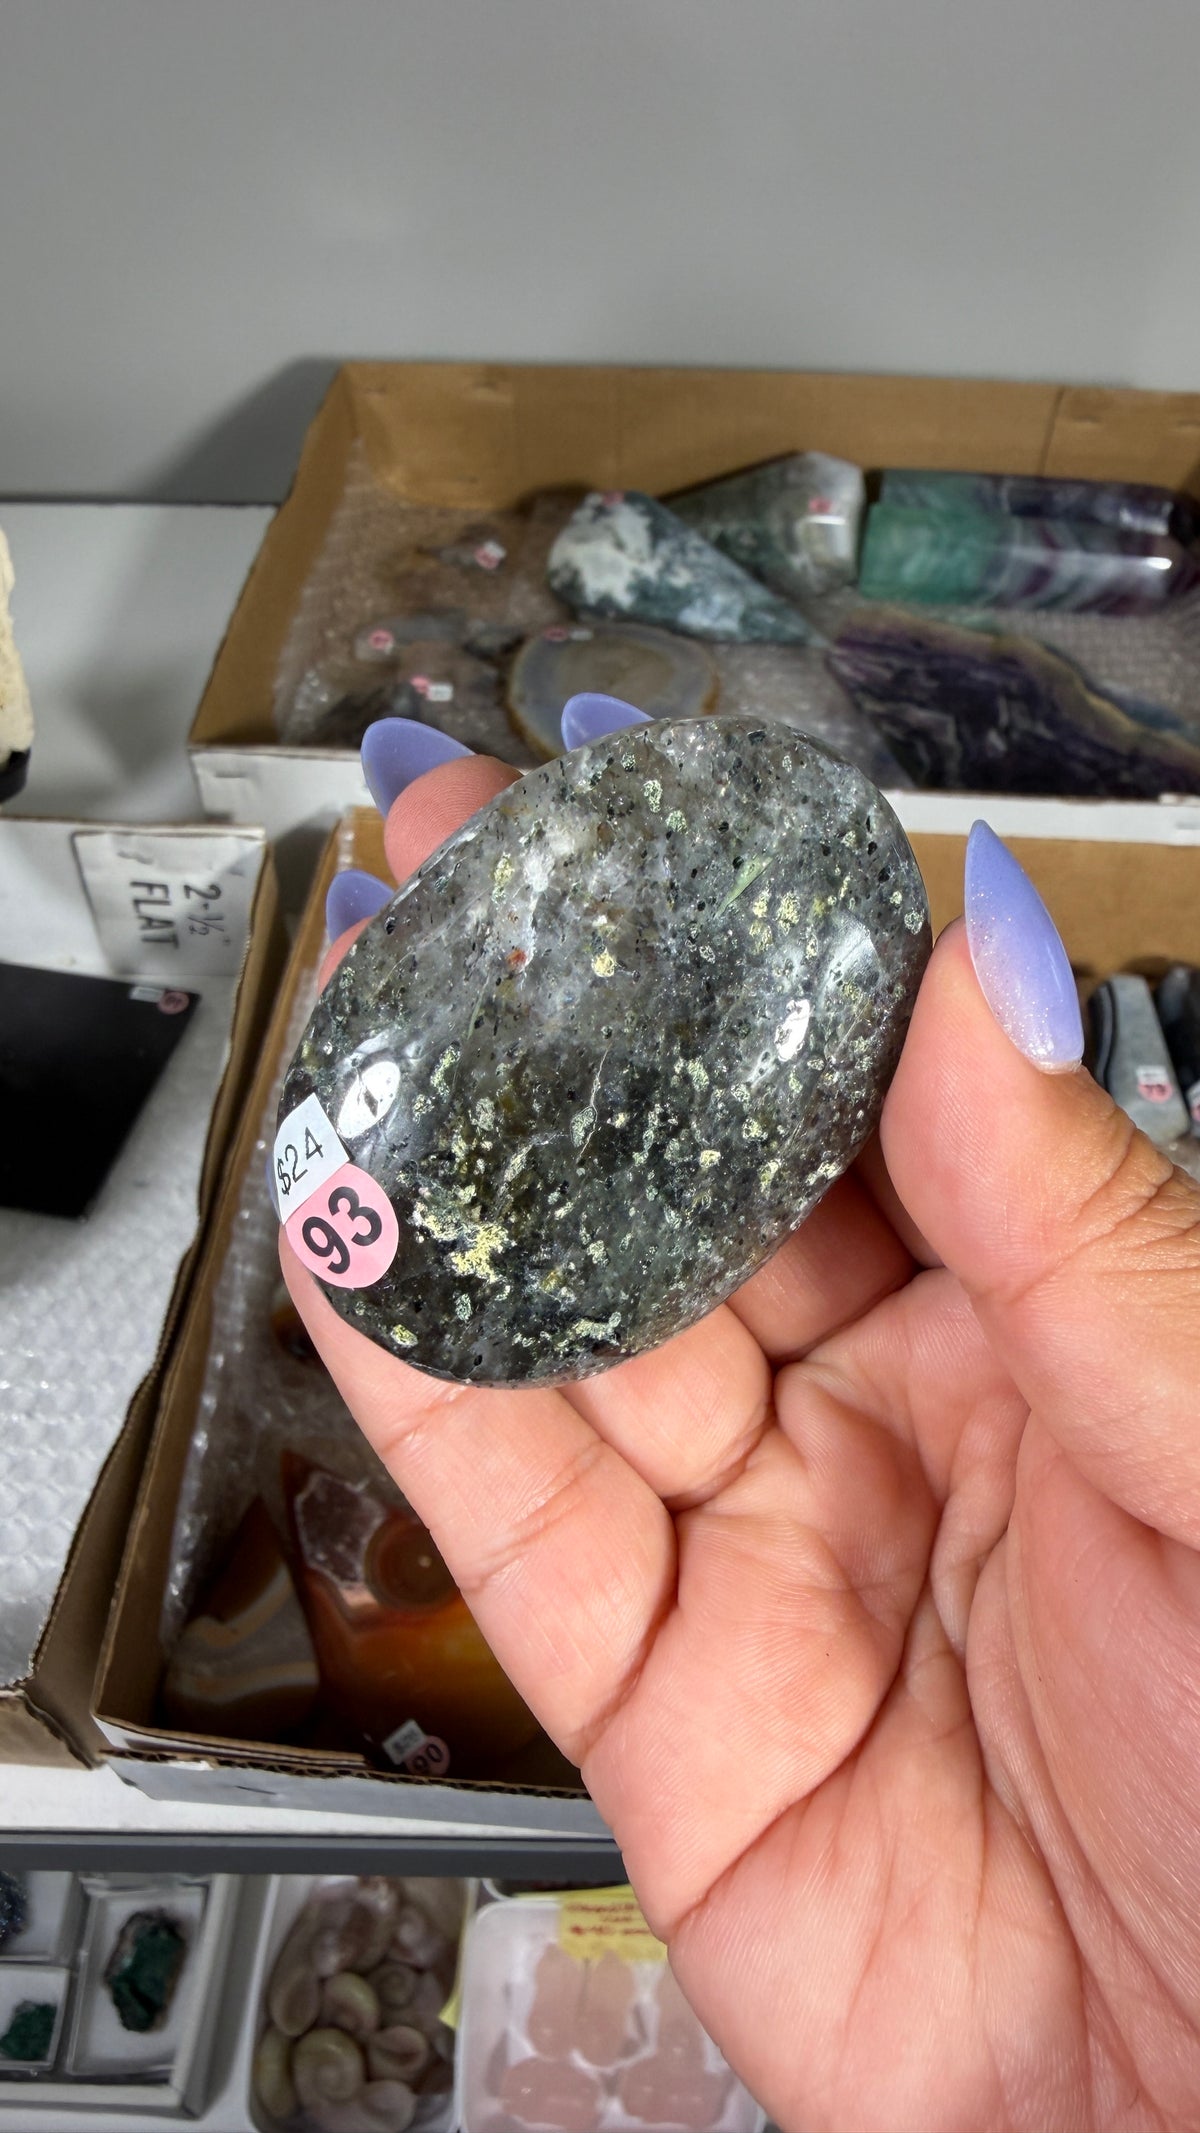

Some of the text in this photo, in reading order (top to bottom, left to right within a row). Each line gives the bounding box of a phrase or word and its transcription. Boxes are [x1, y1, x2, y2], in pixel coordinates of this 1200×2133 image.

[130, 880, 180, 950] FLAT
[276, 1126, 324, 1196] $24
[302, 1186, 383, 1275] 93
